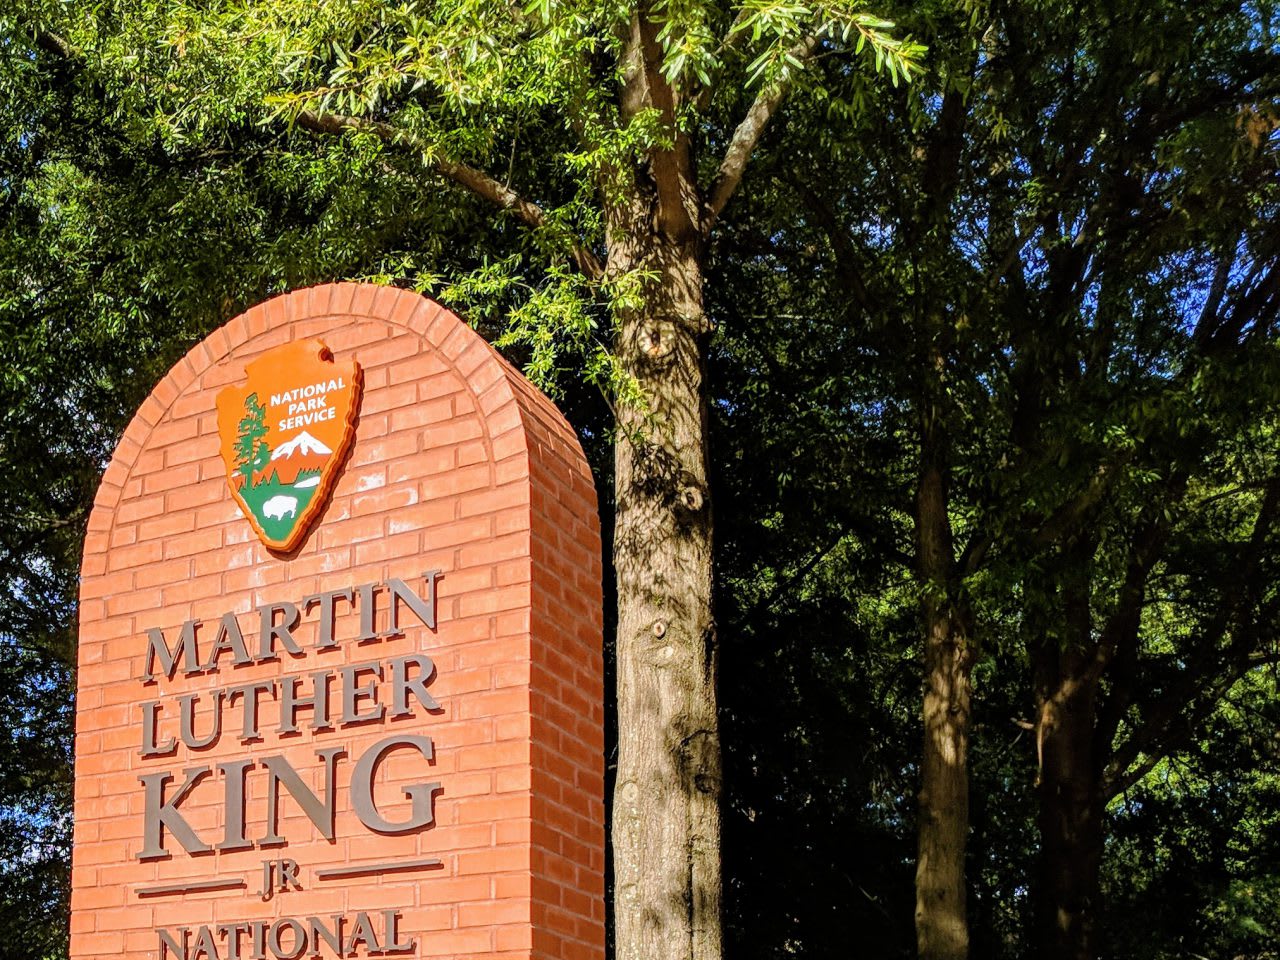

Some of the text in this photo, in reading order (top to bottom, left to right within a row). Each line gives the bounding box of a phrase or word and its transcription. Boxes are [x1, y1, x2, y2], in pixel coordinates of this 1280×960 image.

[270, 377, 346, 407] NATIONAL
[288, 395, 327, 415] PARK
[278, 406, 336, 432] SERVICE
[139, 569, 442, 682] MARTIN
[137, 654, 442, 756] LUTHER
[135, 735, 442, 859] KING
[257, 858, 302, 899] JR
